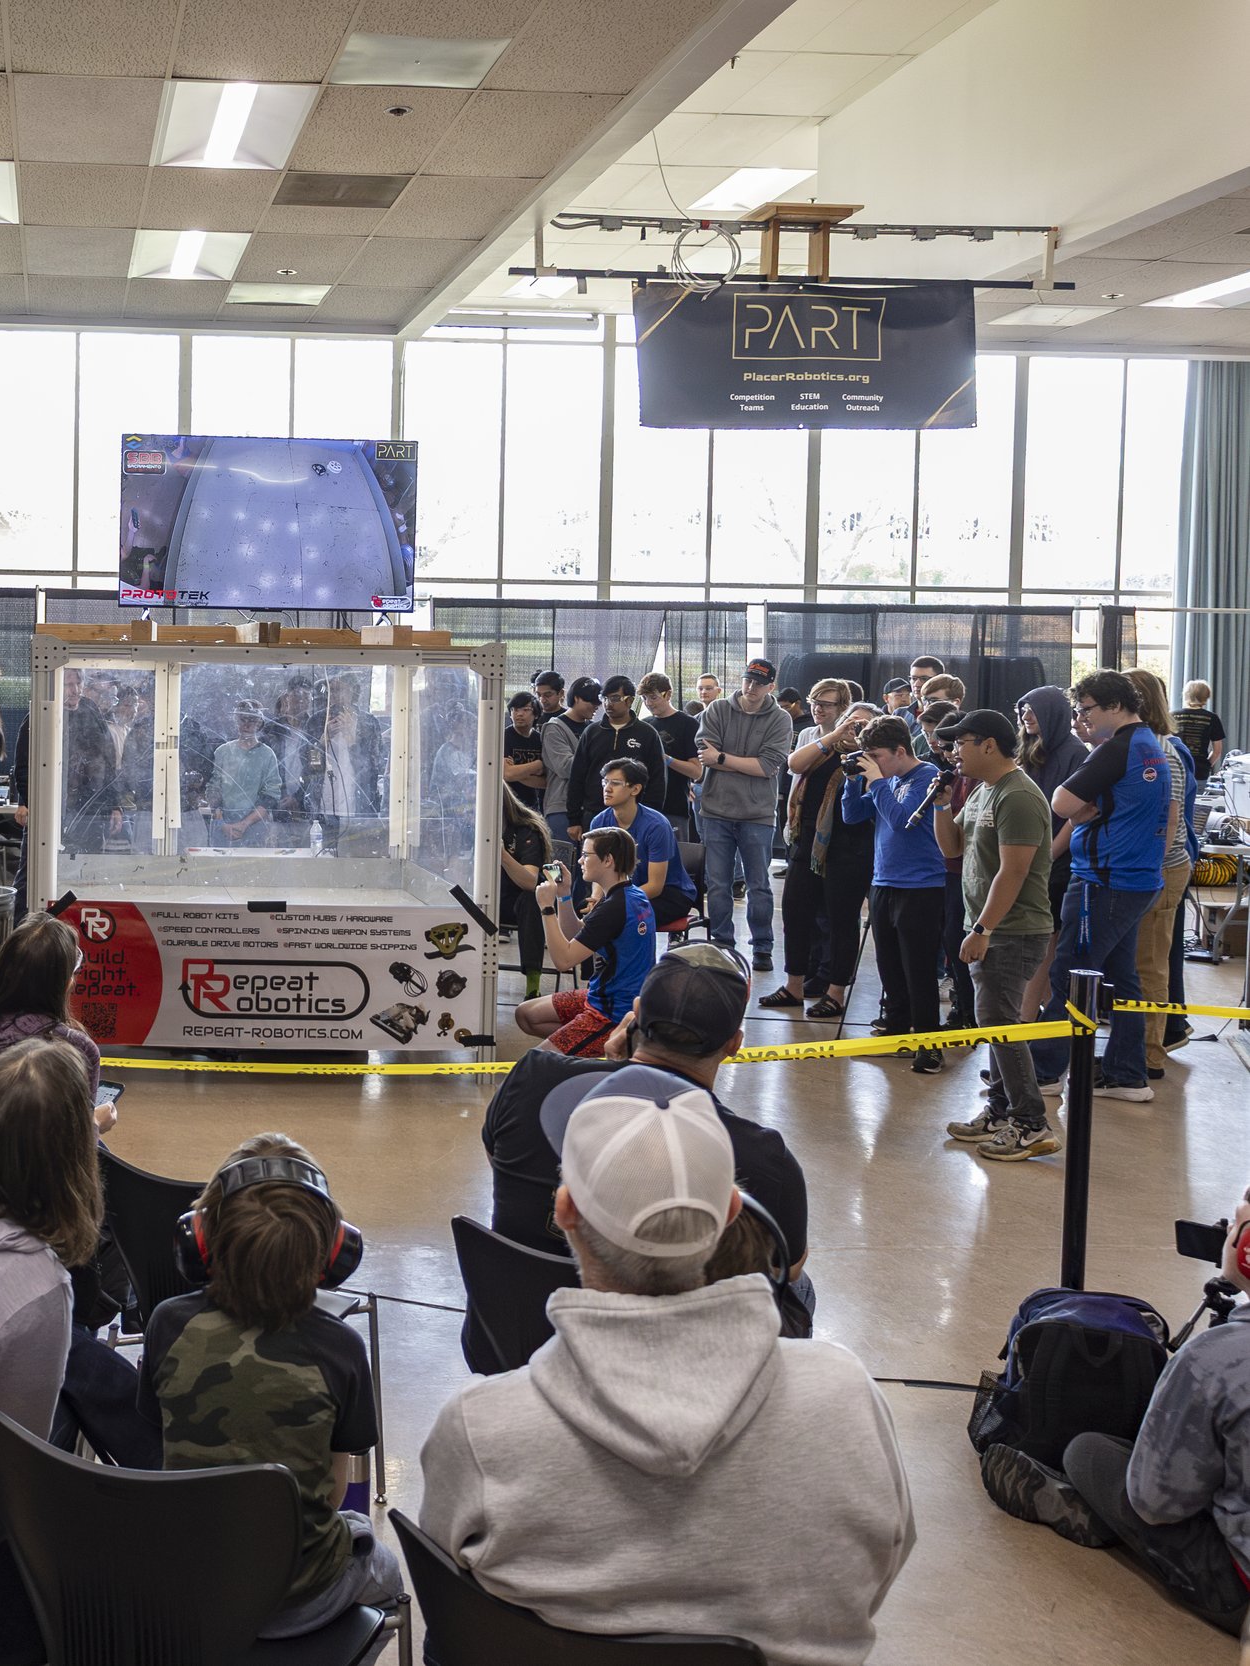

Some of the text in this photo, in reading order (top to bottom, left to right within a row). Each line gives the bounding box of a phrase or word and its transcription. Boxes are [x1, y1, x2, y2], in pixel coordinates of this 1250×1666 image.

[744, 304, 871, 350] PART
[743, 371, 870, 384] PlacerRobotics.org
[729, 393, 775, 402] Competition
[842, 394, 883, 403] Community
[791, 403, 828, 411] Education
[846, 404, 880, 412] Outreach
[378, 444, 413, 458] PART
[121, 589, 211, 600] PROTOTEK
[183, 912, 212, 920] ROBOT
[163, 926, 260, 935] SPEED CONTROLLERS
[370, 929, 411, 937] SYSTEMS
[167, 939, 208, 947] DURABLE
[210, 940, 240, 948] DRIVE
[288, 941, 417, 951] FAST WORLDWIDE SHIPPING
[82, 949, 129, 965] uild.
[74, 966, 130, 985] ight.
[182, 958, 319, 993] Repeat
[71, 983, 141, 998] epeat.
[182, 1025, 363, 1040] REPEAT-ROBOTICS.COM
